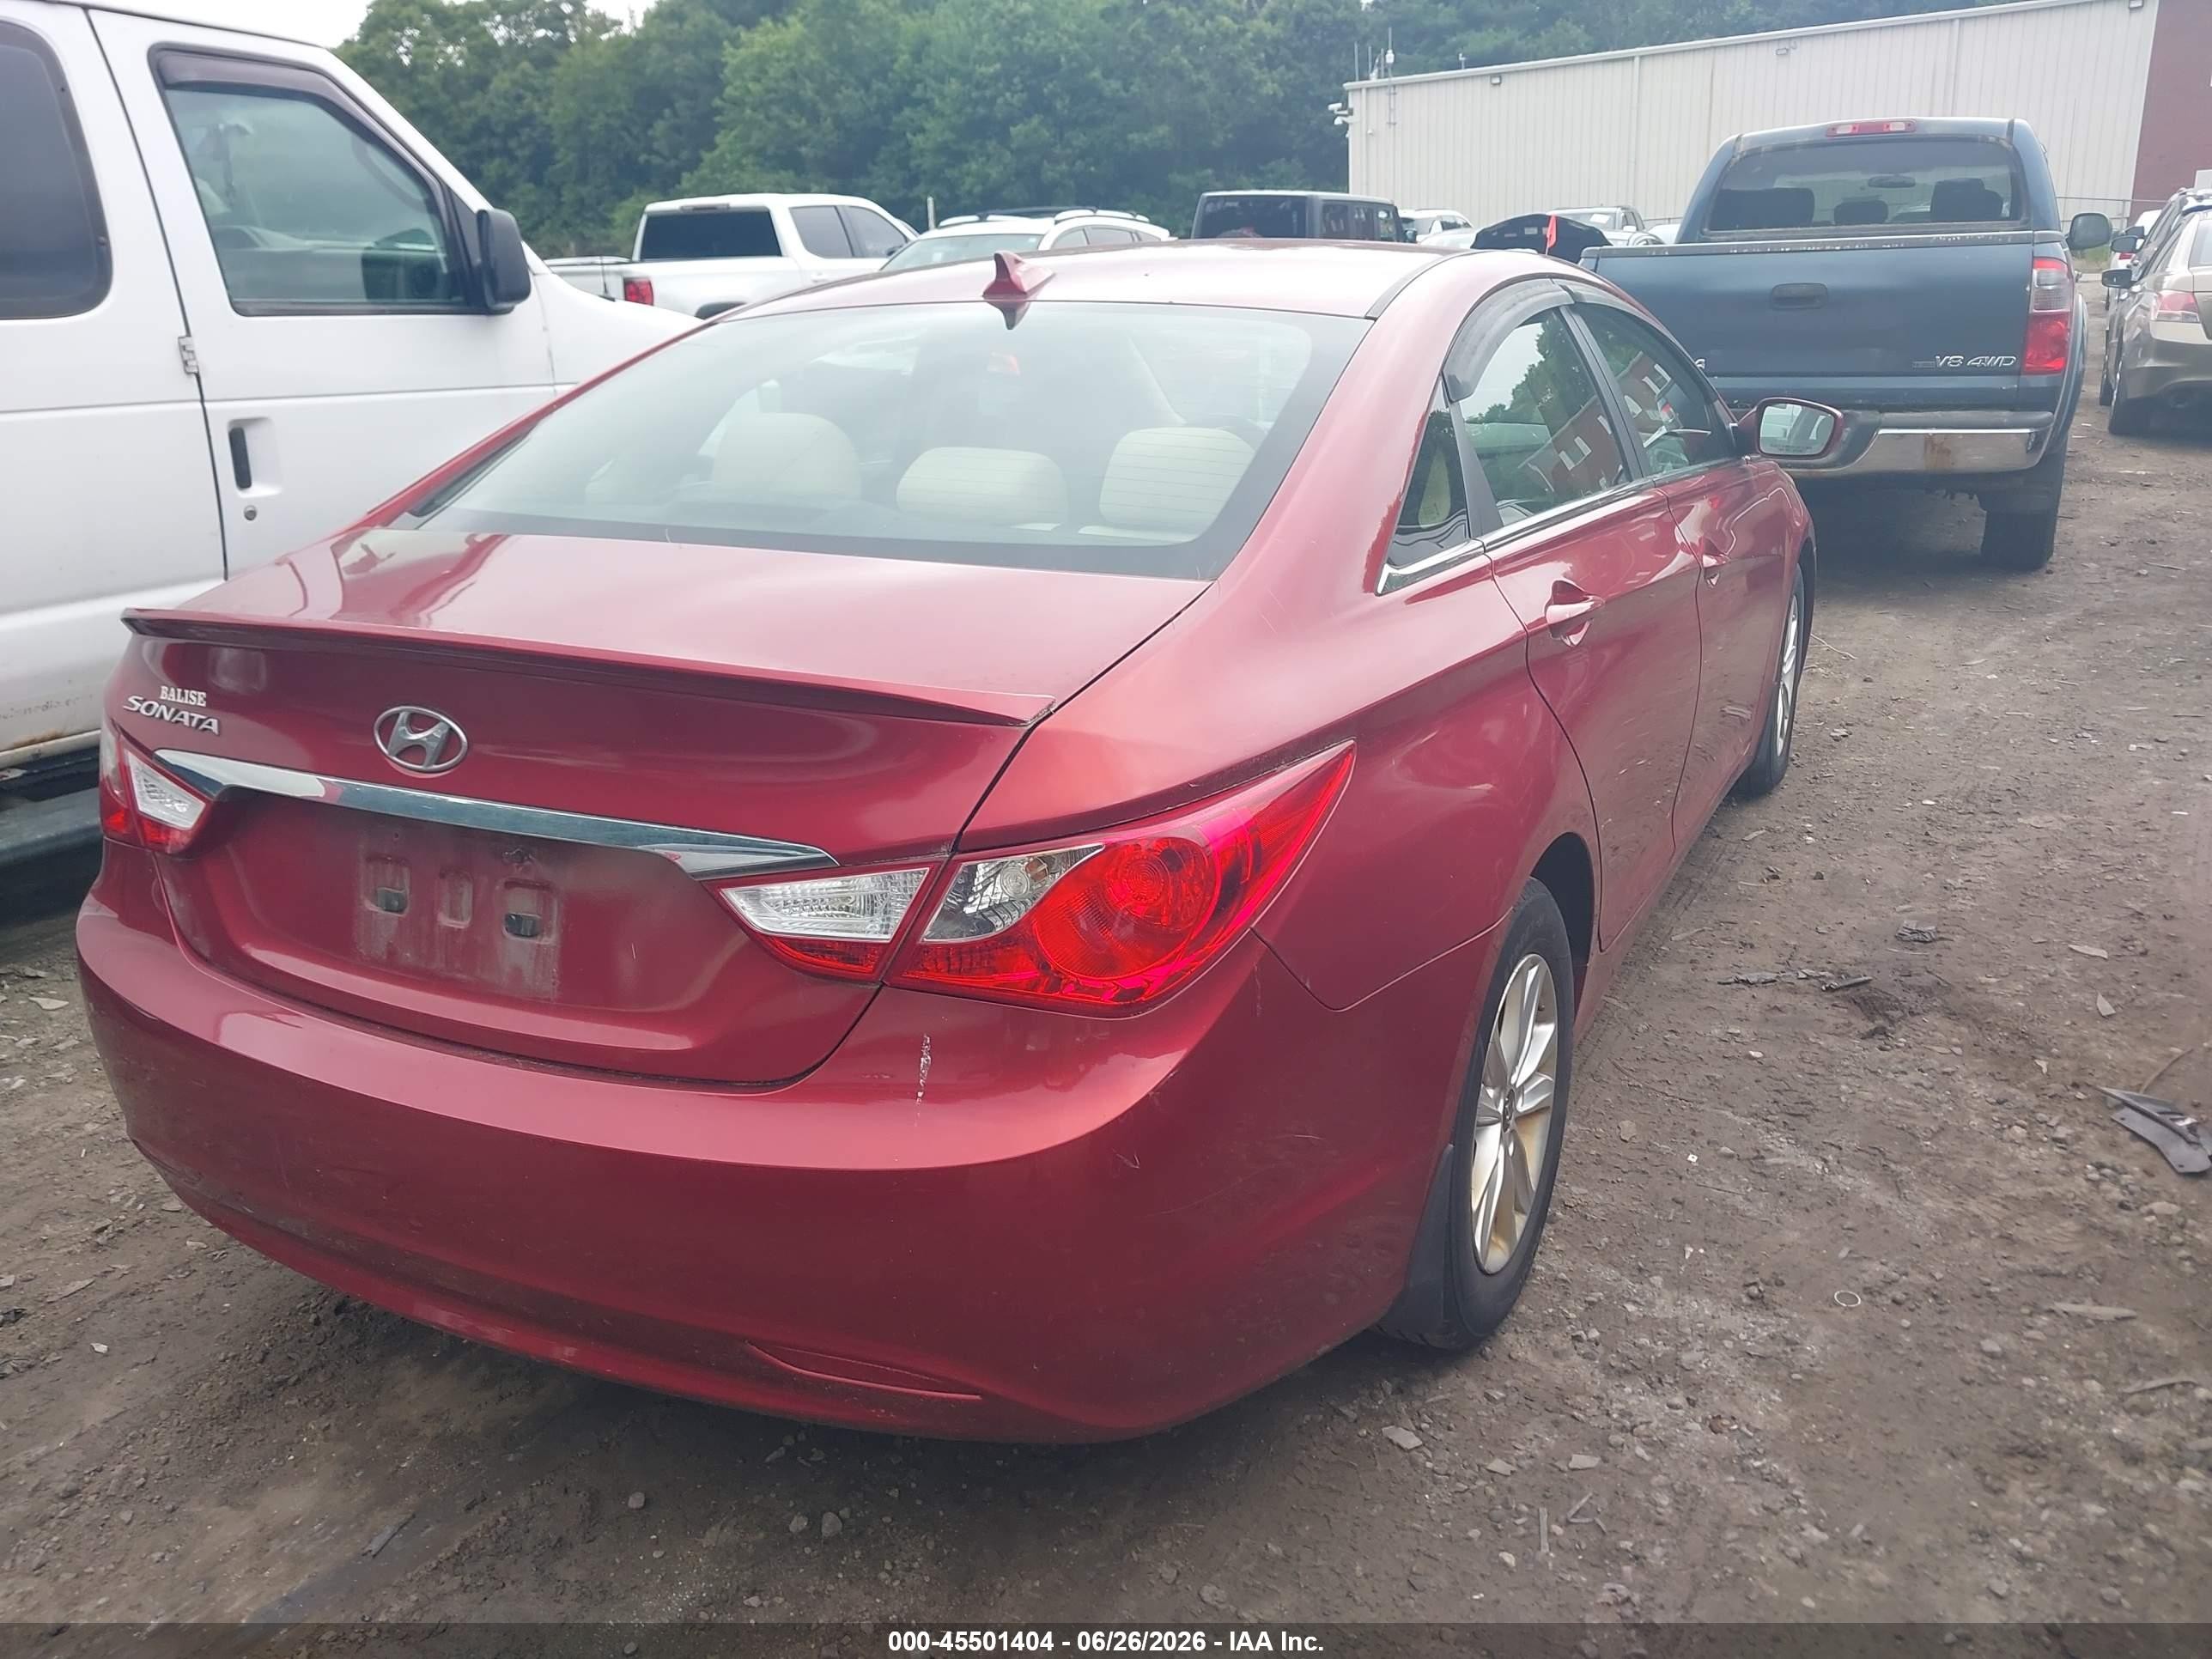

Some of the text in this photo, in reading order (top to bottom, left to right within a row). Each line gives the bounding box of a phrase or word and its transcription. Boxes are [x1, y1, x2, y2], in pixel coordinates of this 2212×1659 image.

[1935, 356, 1964, 368] V8
[1966, 356, 2017, 368] 4WD
[160, 686, 206, 707] BALISE
[123, 696, 219, 735] SONATA
